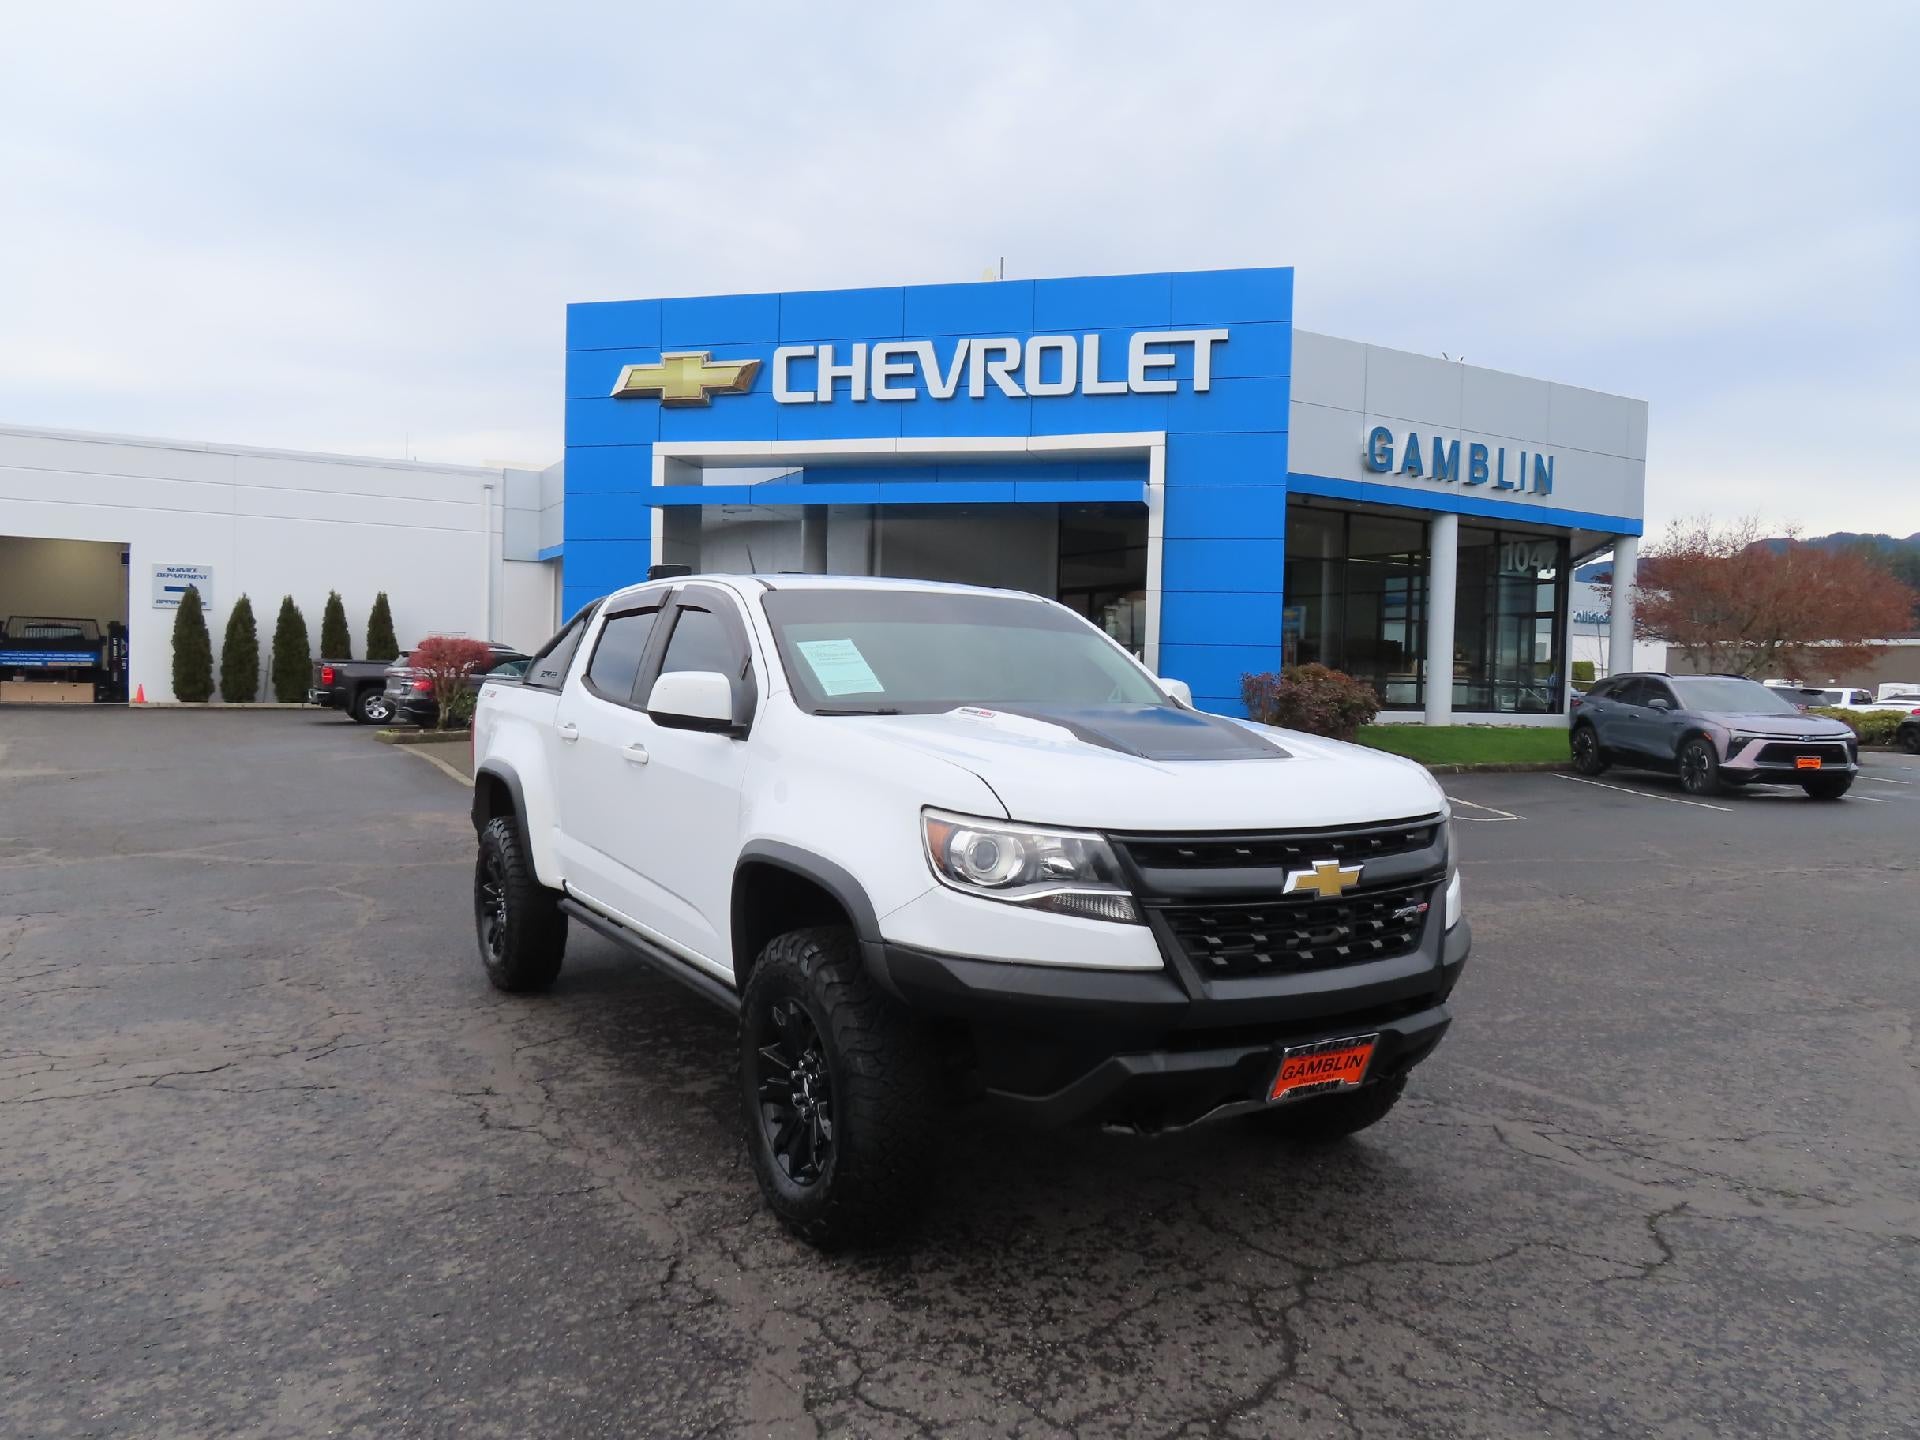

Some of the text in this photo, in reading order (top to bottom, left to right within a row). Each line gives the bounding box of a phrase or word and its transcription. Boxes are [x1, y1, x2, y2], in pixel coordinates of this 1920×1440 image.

[772, 328, 1229, 403] CHEVROLET
[1367, 426, 1554, 495] GAMBLIN
[1282, 1054, 1364, 1080] GAMBLIN
